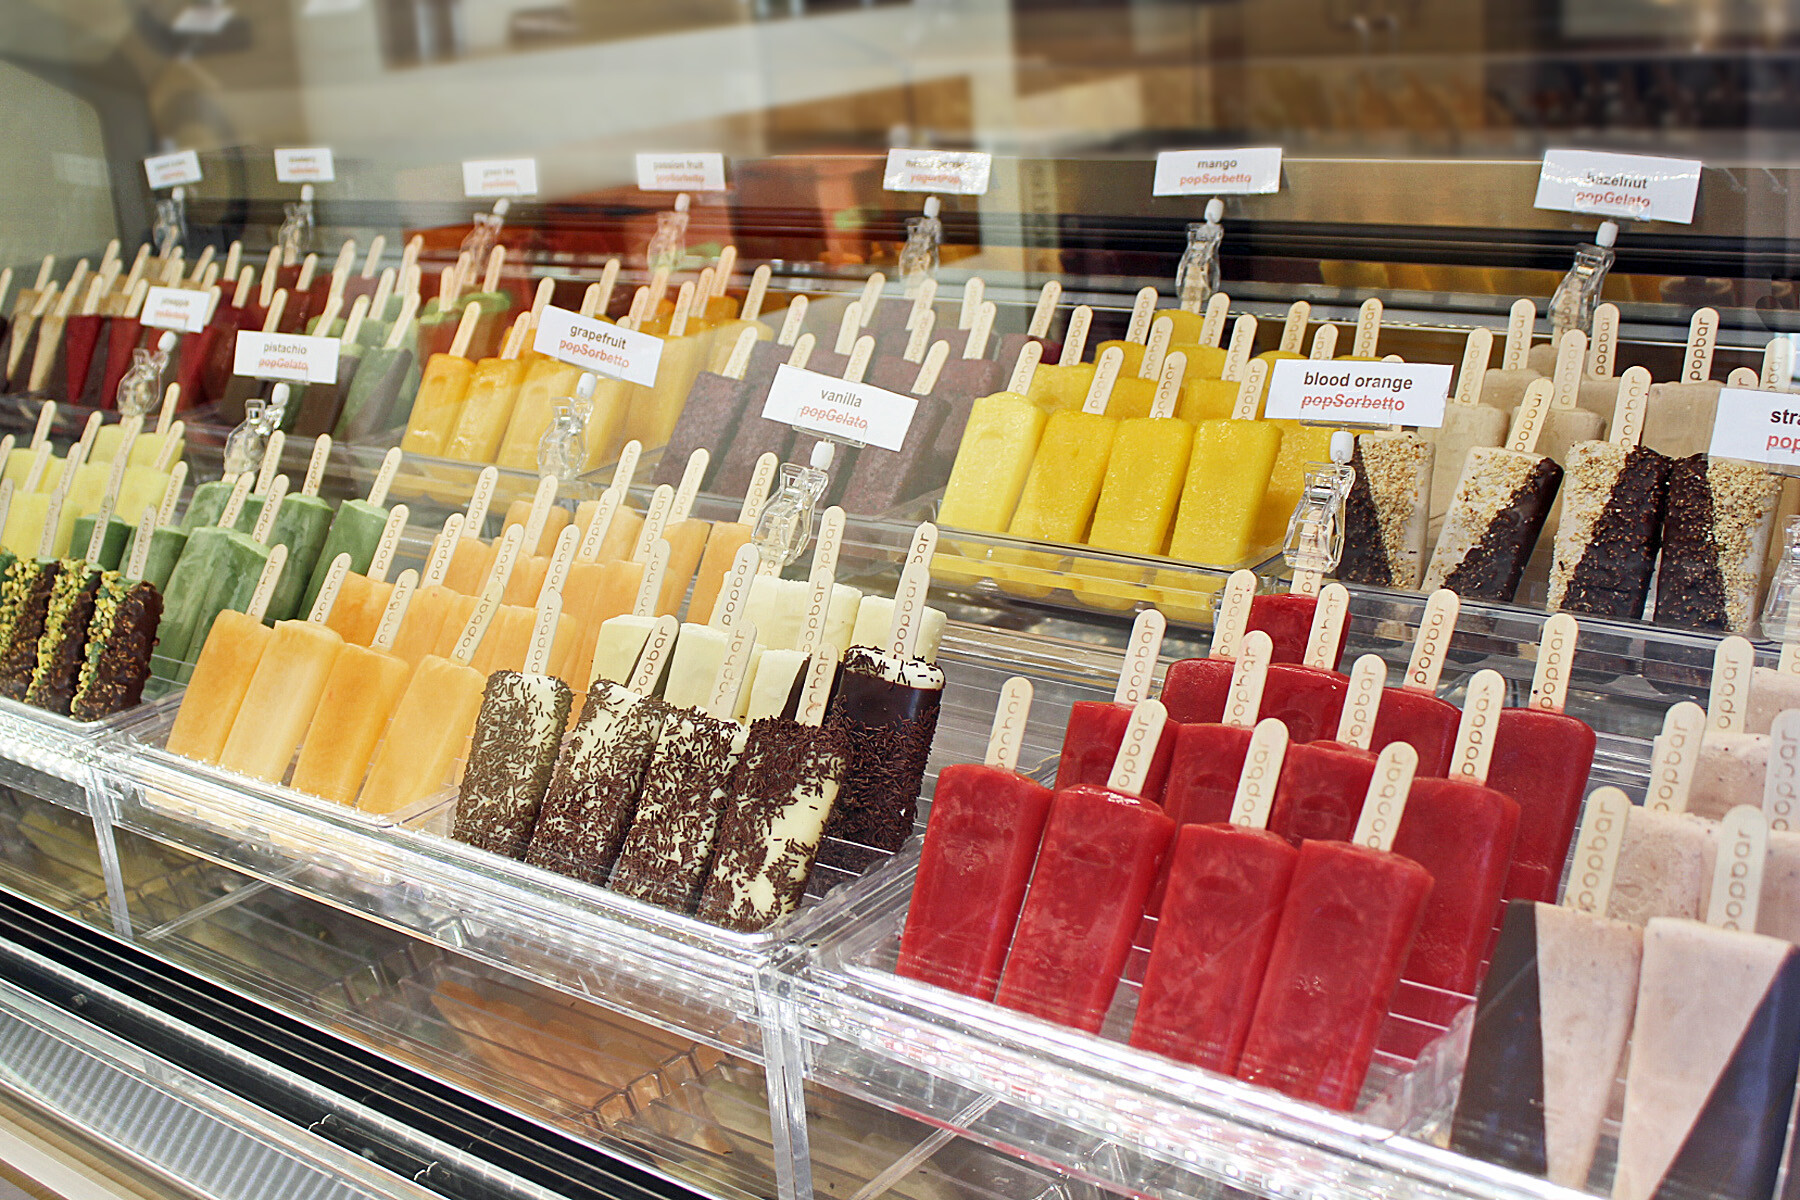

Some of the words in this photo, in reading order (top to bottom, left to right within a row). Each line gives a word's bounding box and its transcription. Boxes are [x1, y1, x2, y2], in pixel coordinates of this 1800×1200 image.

[1180, 173, 1252, 187] popSorbetto
[1197, 159, 1237, 170] mango
[258, 357, 309, 371] popGelato
[263, 341, 307, 355] pistachio
[559, 340, 630, 368] popSorbetto
[570, 325, 627, 350] grapefruit
[1595, 316, 1610, 376] popbar
[1689, 317, 1710, 381] popbar
[820, 389, 863, 408] vanilla
[1301, 393, 1405, 411] popSorbetto
[1303, 372, 1351, 387] blood
[1355, 377, 1413, 392] orange
[800, 405, 869, 429] popGelato
[747, 458, 771, 518] popbar
[376, 512, 402, 570] popbar
[431, 520, 459, 580] popbar
[818, 518, 838, 570] pbar
[722, 555, 750, 627] popbar
[803, 580, 827, 653] popbar
[893, 578, 918, 661] popbar
[457, 594, 495, 660] popbar
[530, 604, 554, 673] popbar
[1414, 606, 1445, 686] popbar
[634, 625, 669, 696] popbar
[1540, 628, 1564, 710] popbar
[1578, 801, 1616, 913] popbar
